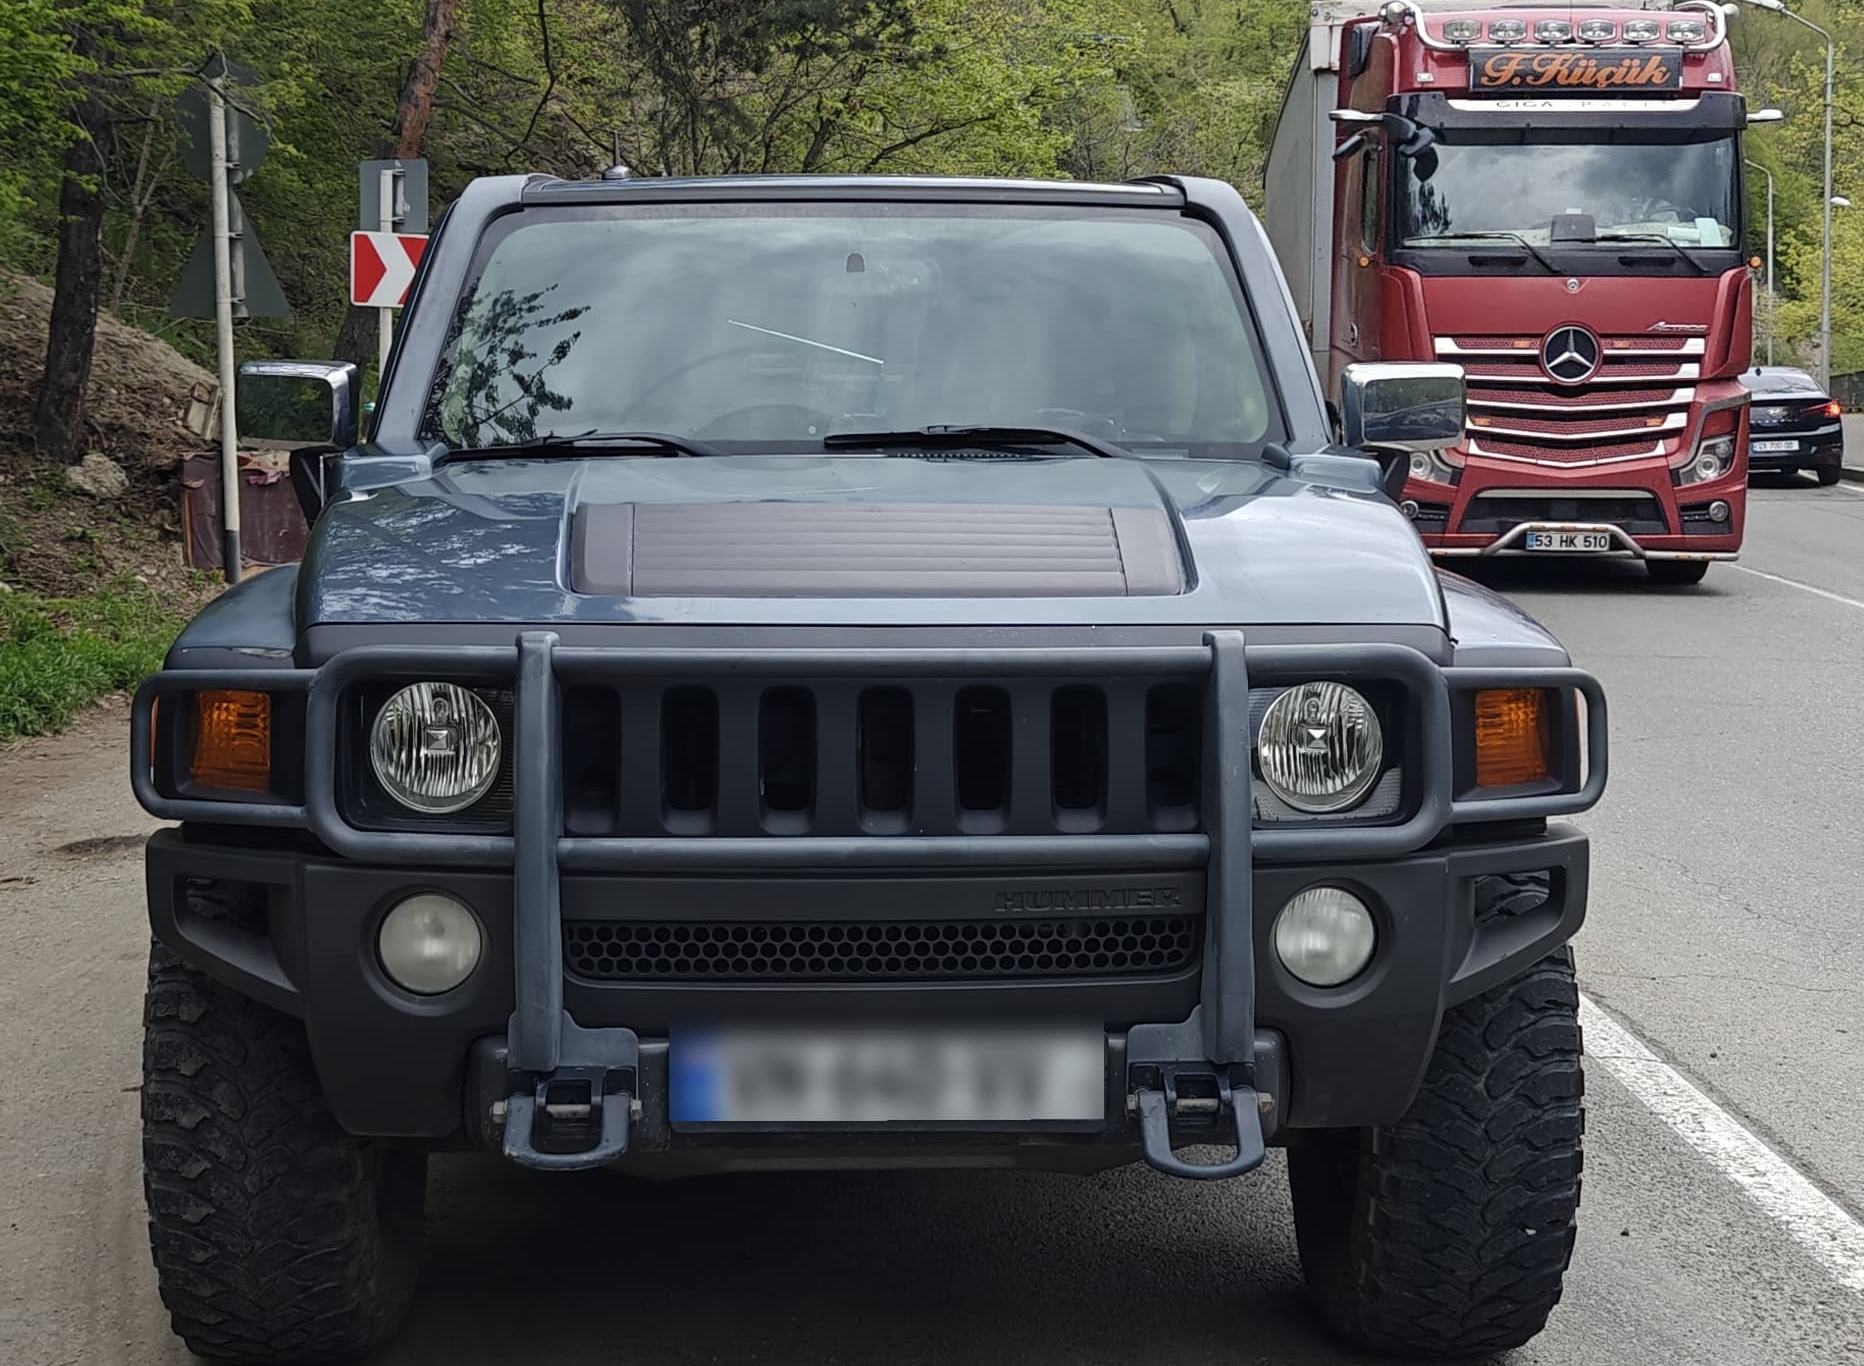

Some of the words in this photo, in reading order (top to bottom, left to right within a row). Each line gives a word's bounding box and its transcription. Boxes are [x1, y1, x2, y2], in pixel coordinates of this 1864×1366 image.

[1535, 534, 1553, 547] 53
[1560, 535, 1577, 548] HK
[1583, 536, 1608, 548] 510
[995, 887, 1183, 912] HUMMER
